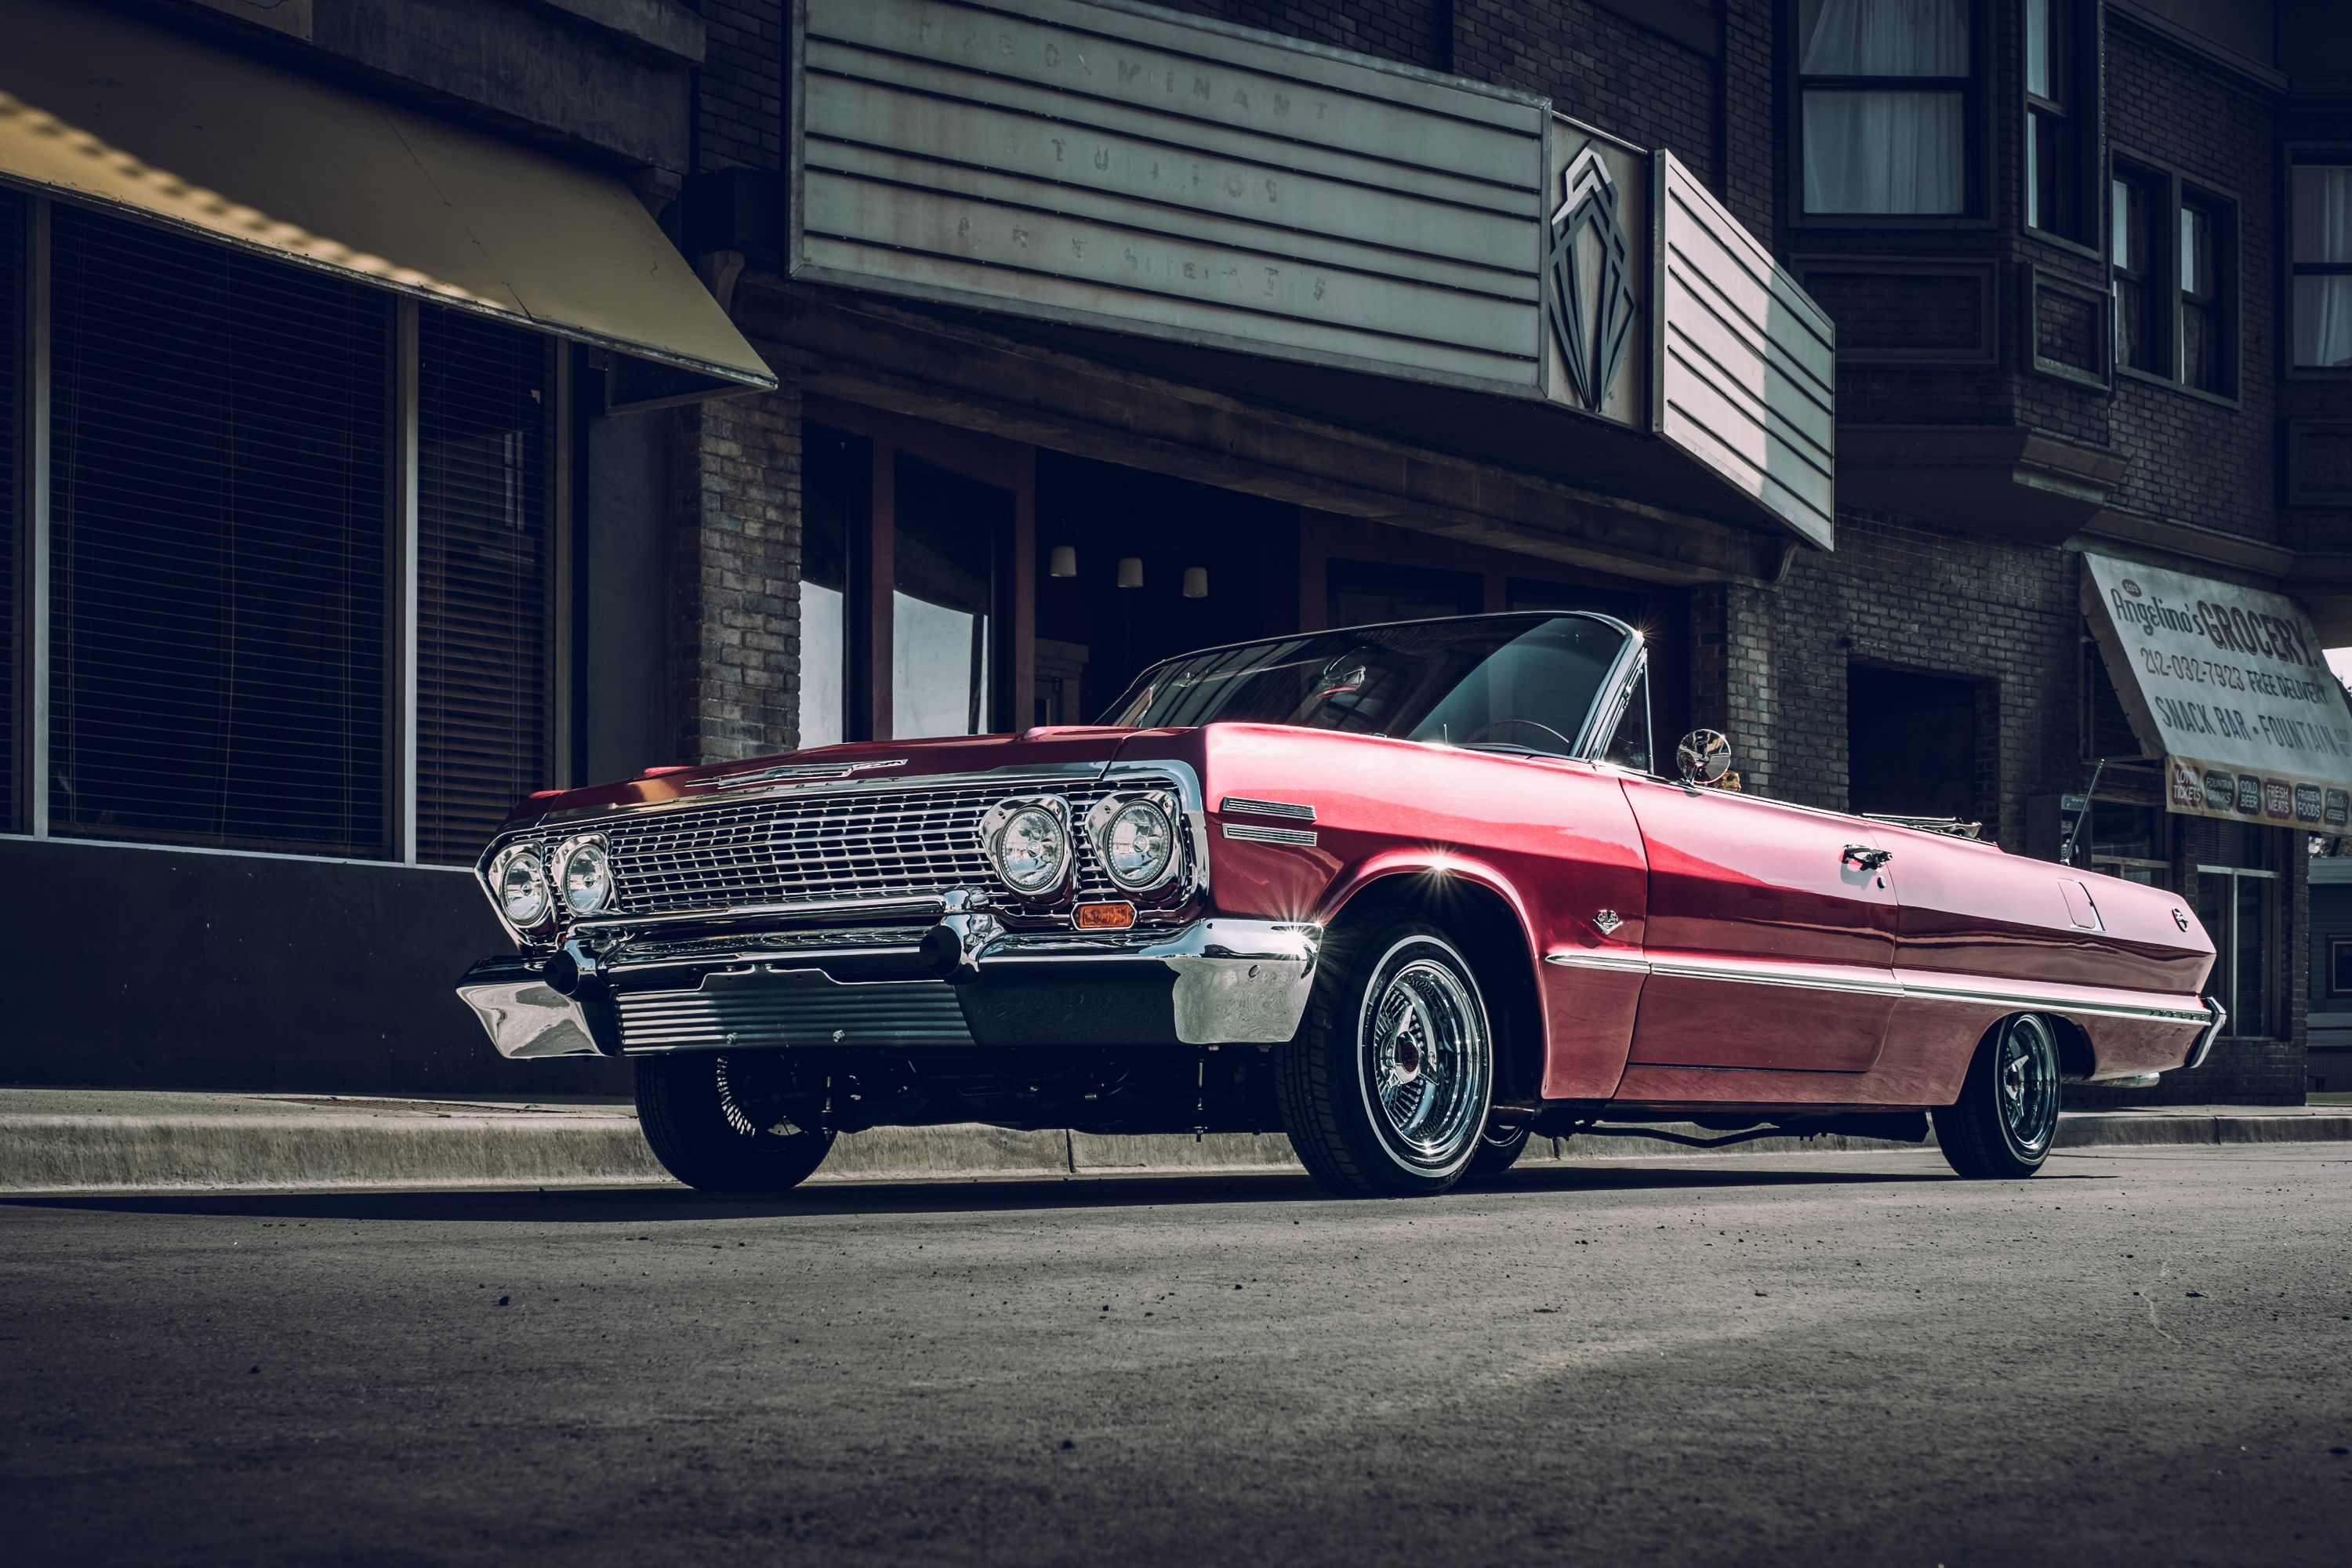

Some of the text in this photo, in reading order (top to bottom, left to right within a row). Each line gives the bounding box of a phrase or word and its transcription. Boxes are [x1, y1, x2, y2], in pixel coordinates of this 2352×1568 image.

[2111, 588, 2205, 637] Angelino's
[2140, 648, 2329, 706] 212-032-7923 FREE DELIVERY
[2154, 695, 2217, 735] SNACK
[2213, 706, 2252, 742] BAR
[2258, 714, 2339, 756] FOUNTAIN
[2205, 777, 2233, 789] FOUNTAIN
[2241, 780, 2258, 795] COLD
[2173, 785, 2201, 802] TICKETS
[2207, 789, 2232, 804] DRINKS
[2267, 785, 2288, 800] FRESH
[2297, 789, 2321, 803] FROZEN
[2240, 794, 2258, 809] BEER
[2267, 799, 2289, 814] MEATS
[2298, 801, 2321, 818] FOODS
